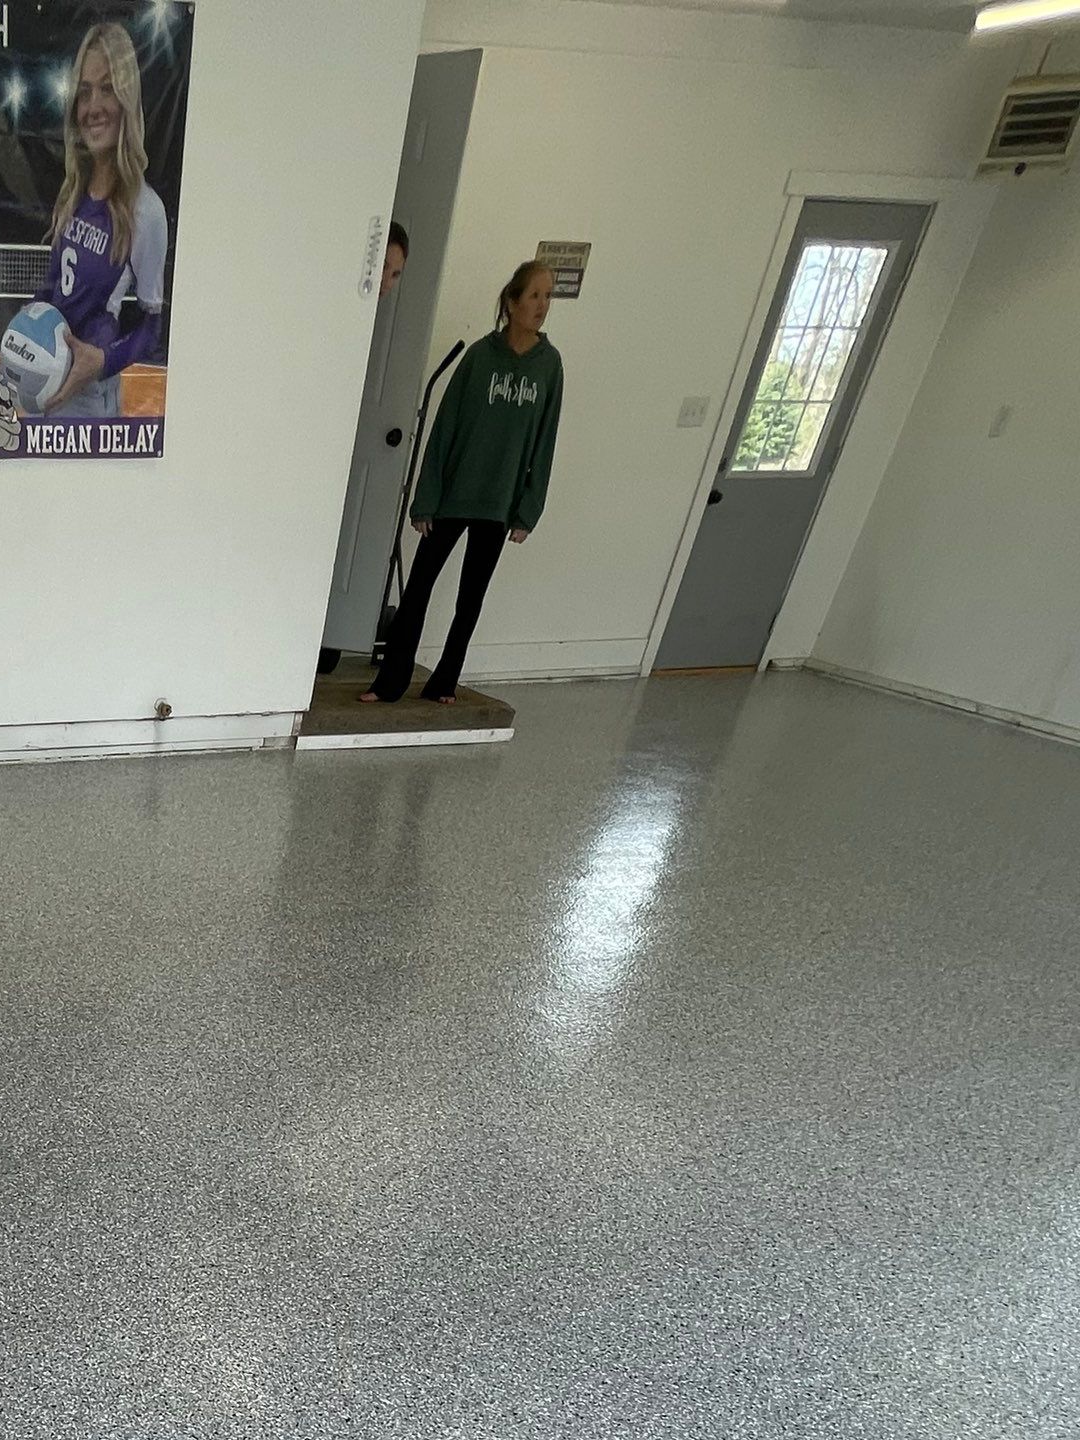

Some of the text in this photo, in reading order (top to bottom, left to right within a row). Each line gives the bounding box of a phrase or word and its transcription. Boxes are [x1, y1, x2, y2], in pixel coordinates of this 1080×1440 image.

[61, 247, 77, 297] 6
[26, 425, 159, 454] MEGAN DELAY
